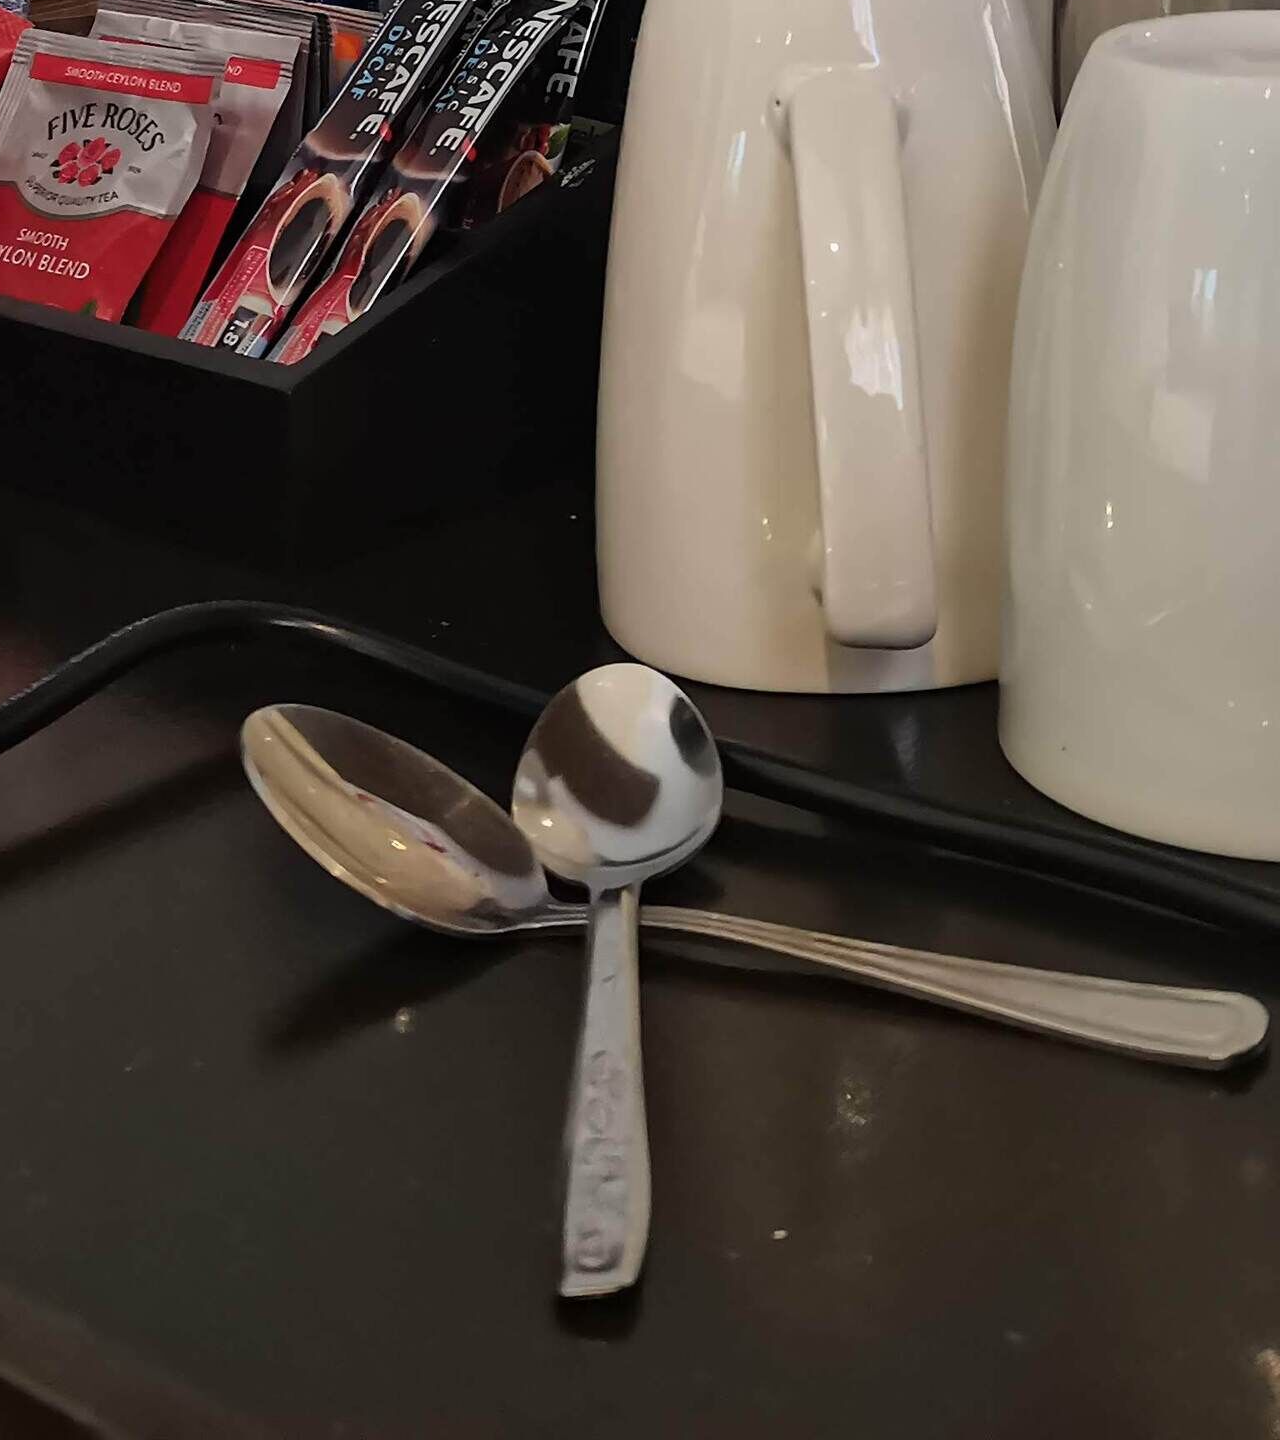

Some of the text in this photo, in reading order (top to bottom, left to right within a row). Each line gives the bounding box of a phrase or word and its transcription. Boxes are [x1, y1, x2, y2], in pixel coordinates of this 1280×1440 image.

[350, 25, 406, 101] DECAF
[435, 39, 491, 113] DECAF
[65, 66, 182, 93] SMOOTH CEYLON BLEND
[47, 102, 165, 152] FIVE ROSES
[96, 190, 119, 203] TEA
[16, 227, 70, 251] SMOOTH
[37, 253, 91, 280] BLEND
